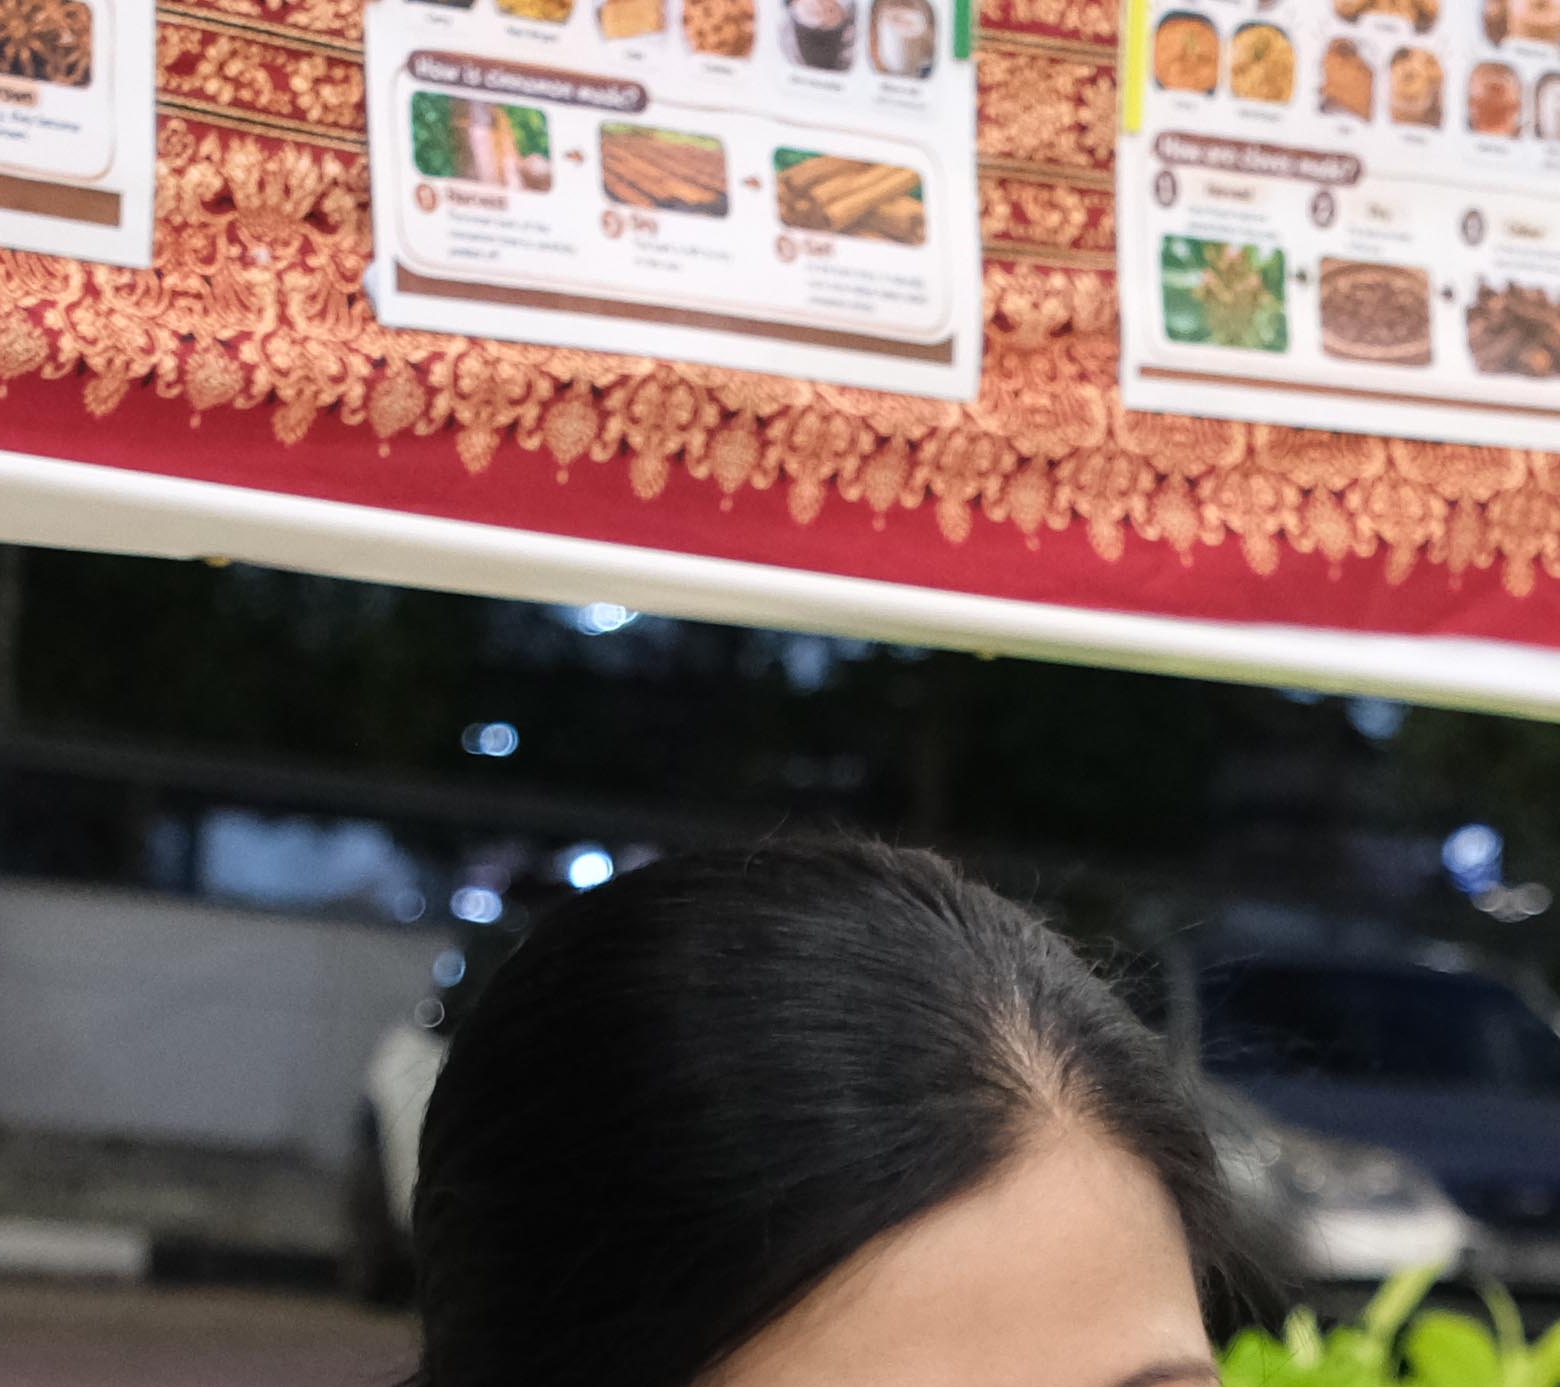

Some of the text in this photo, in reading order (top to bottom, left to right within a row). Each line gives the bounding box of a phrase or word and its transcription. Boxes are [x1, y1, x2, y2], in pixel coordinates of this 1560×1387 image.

[414, 55, 460, 82] How
[462, 62, 482, 87] is
[576, 81, 642, 108] made?
